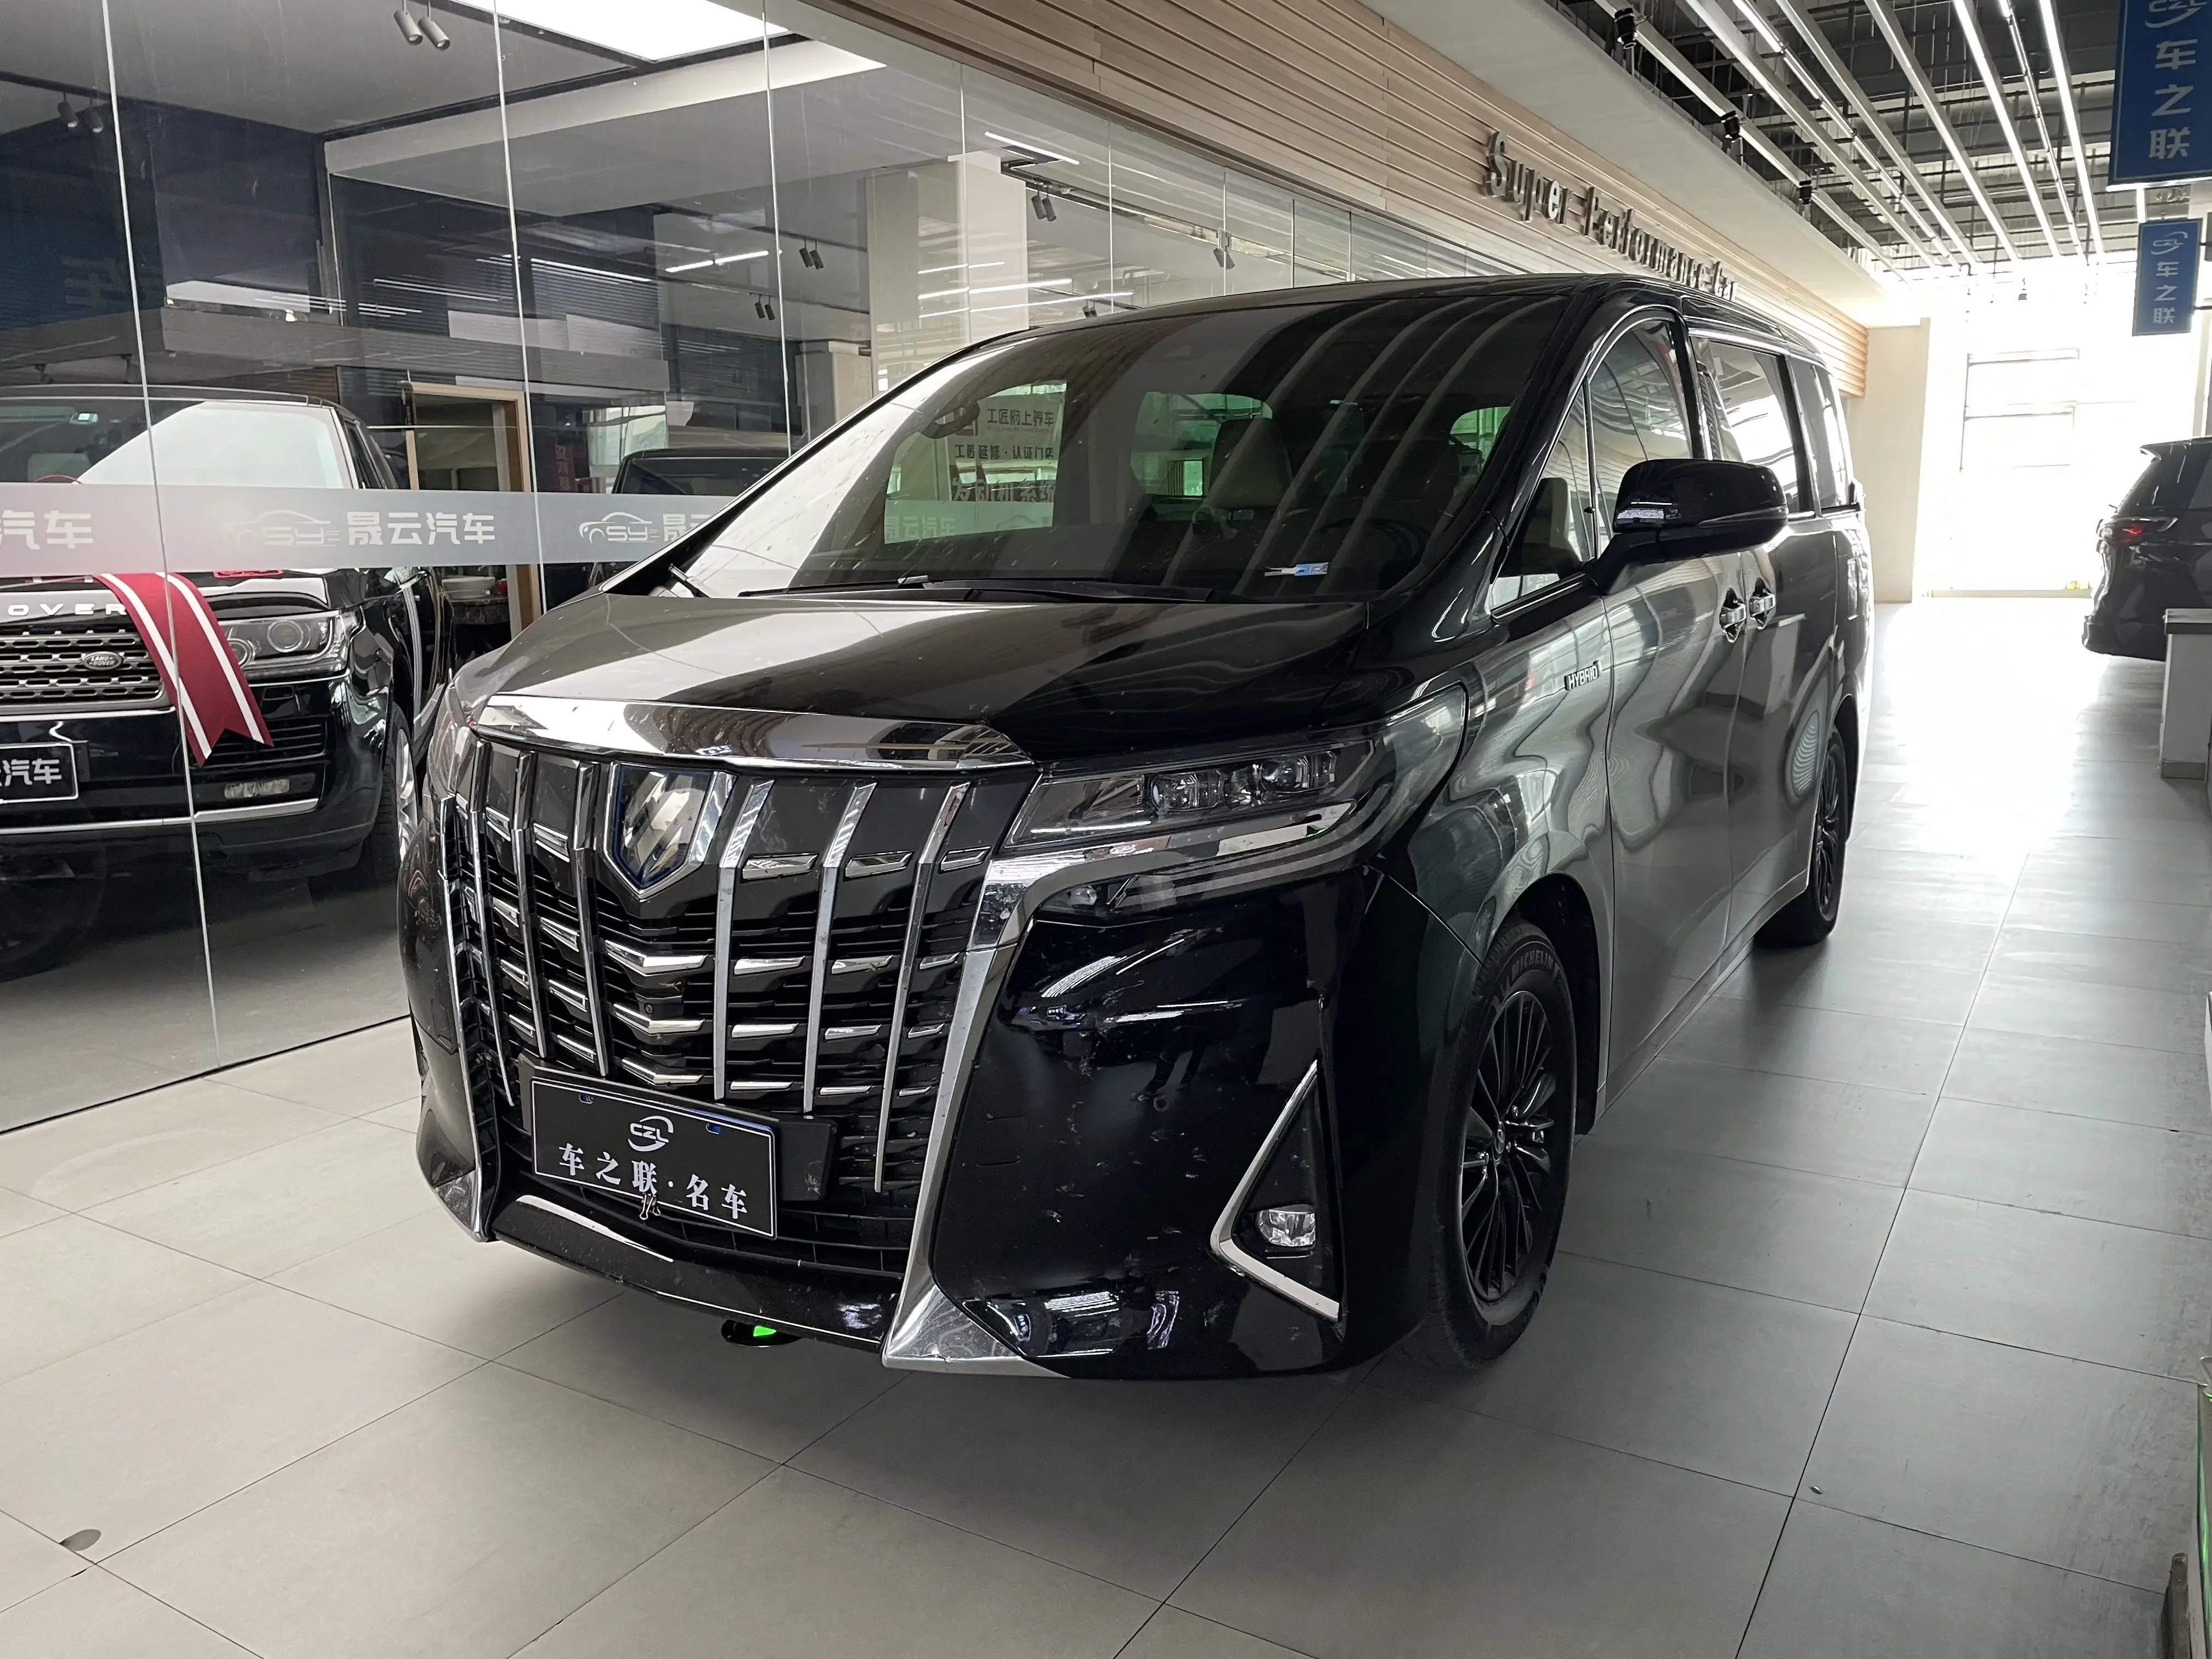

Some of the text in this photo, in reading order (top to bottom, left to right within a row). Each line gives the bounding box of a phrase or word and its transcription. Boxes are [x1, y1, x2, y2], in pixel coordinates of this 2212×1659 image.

[2148, 38, 2198, 160] 车之联
[1482, 131, 1573, 224] Super
[2153, 261, 2179, 324] 车之联
[347, 511, 495, 545] 晟云汽车
[1567, 664, 1599, 690] HYBRID
[0, 758, 62, 787] 汽车
[1511, 950, 1554, 982] MICHELIN
[558, 1142, 748, 1220] 车之联·名车
